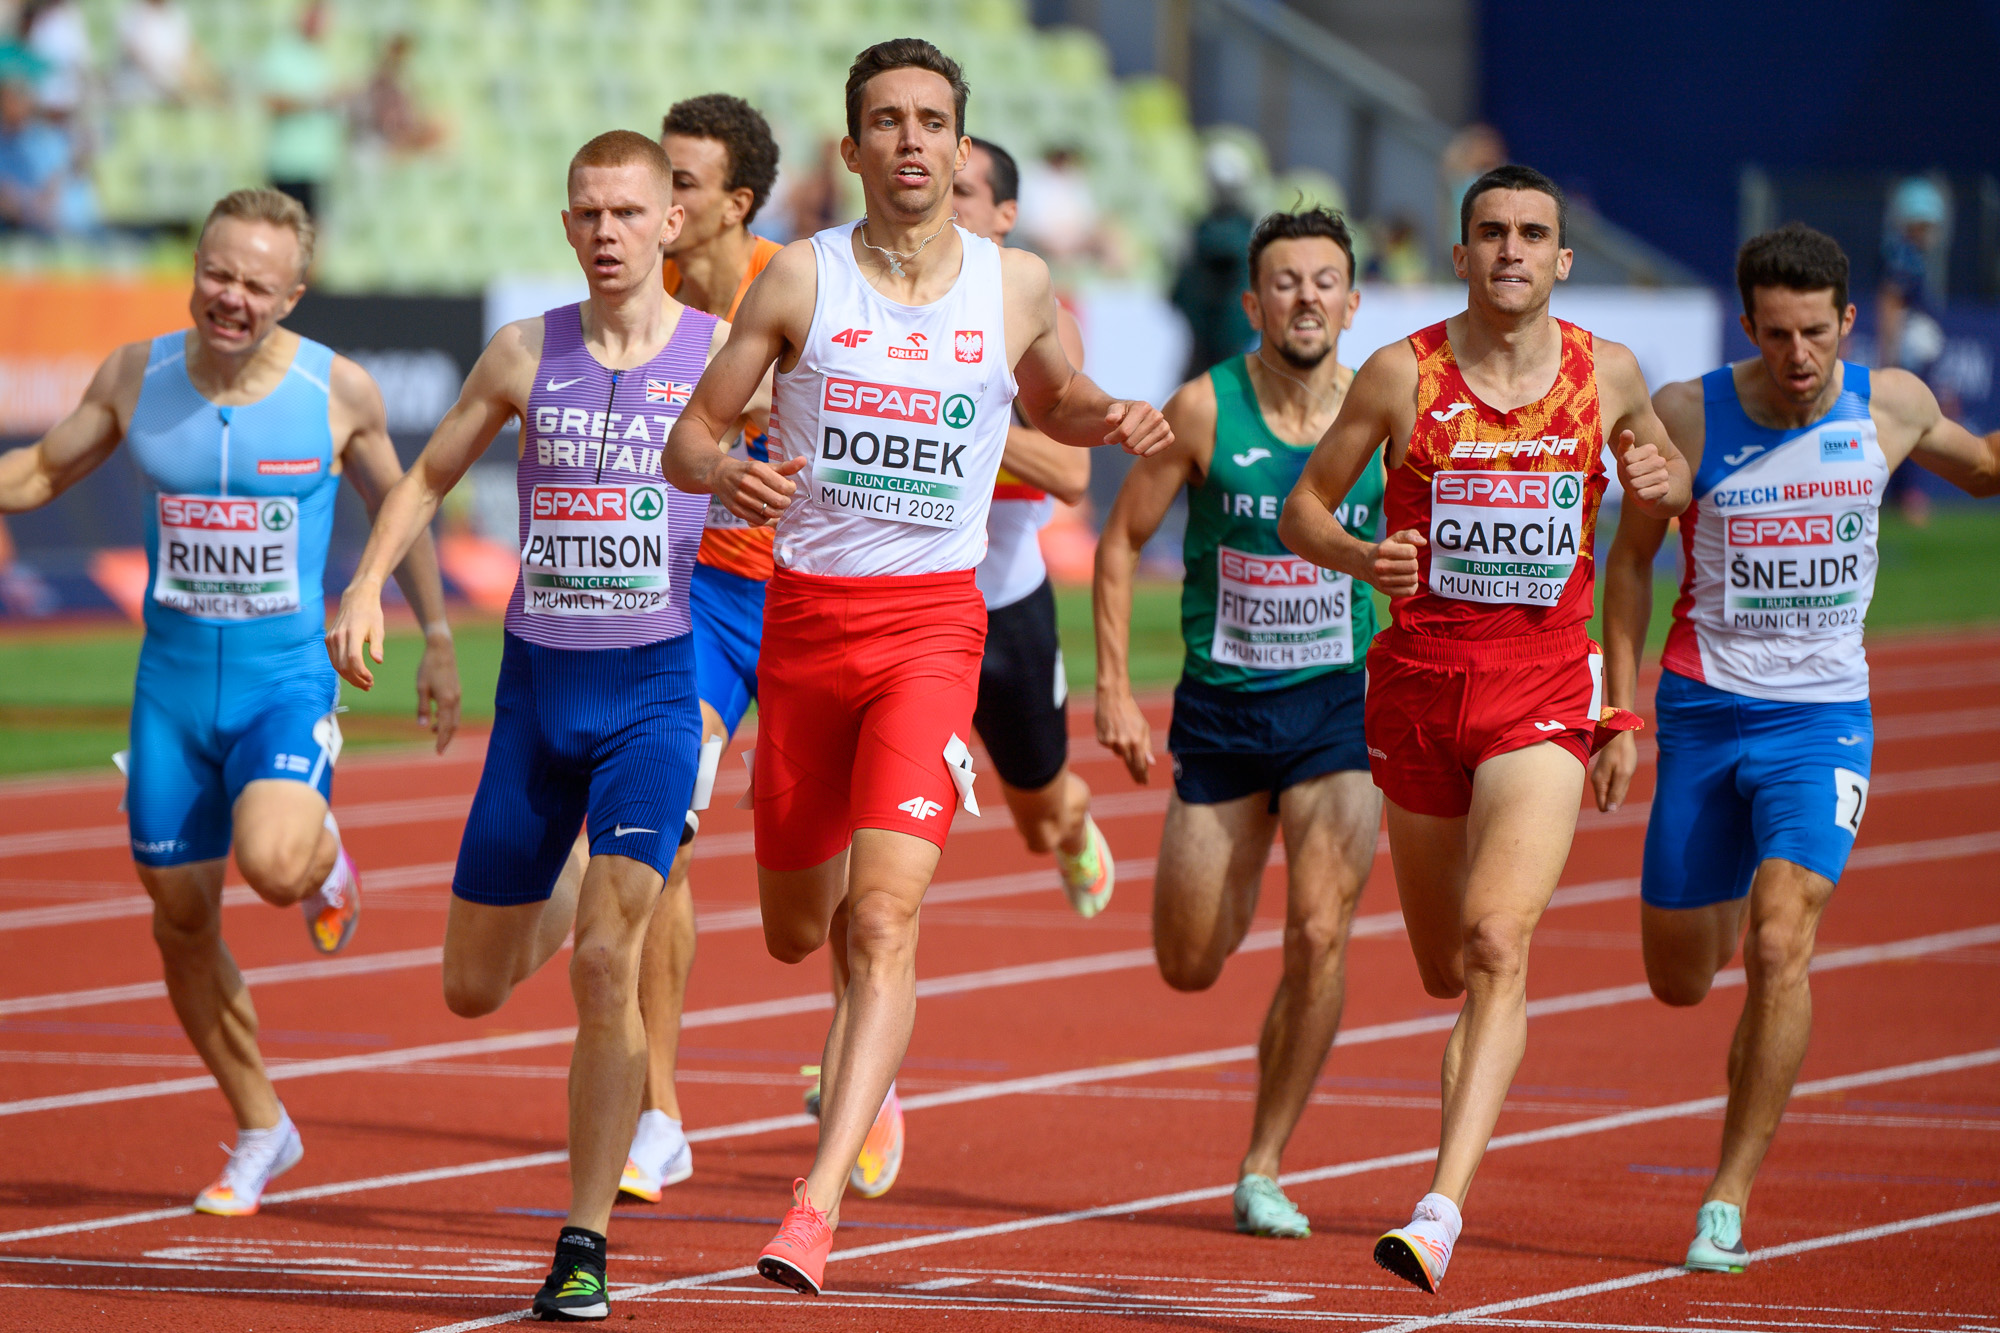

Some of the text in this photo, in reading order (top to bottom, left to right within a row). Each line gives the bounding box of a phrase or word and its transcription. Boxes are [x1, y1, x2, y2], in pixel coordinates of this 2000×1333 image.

[889, 348, 926, 359] ORLEN
[827, 383, 937, 419] SPAR
[536, 407, 675, 442] GREAT
[822, 426, 967, 478] DOBEK
[1449, 436, 1579, 458] ESPAÑA
[847, 473, 852, 484] I
[855, 474, 884, 488] RUN
[1440, 478, 1546, 504] SPAR
[1714, 479, 1873, 507] CZECH REPUBLIC
[162, 500, 256, 528] SPAR
[536, 492, 624, 517] SPAR
[821, 487, 955, 522] MUNICH 2022
[1436, 517, 1575, 556] GARCÍA
[1731, 518, 1830, 544] SPAR
[168, 542, 284, 574] RINNE
[525, 535, 661, 568] PATTISON
[1223, 555, 1317, 584] SPAR
[1466, 562, 1470, 573] I
[1473, 564, 1502, 575] RUN
[1731, 553, 1858, 590] ŠNEJDR
[194, 582, 219, 592] RUN
[560, 576, 584, 588] RUN
[1440, 575, 1519, 597] MUNICH
[164, 595, 289, 614] MUNICH 2022
[533, 591, 660, 610] MUNICH 2022
[1222, 591, 1345, 625] FITZSIMONS
[1766, 598, 1792, 609] RUN
[1735, 608, 1858, 629] MUNICH 2022
[1223, 642, 1344, 664] MUNICH 2022
[1850, 784, 1862, 829] 2
[562, 1237, 596, 1249] adidas
